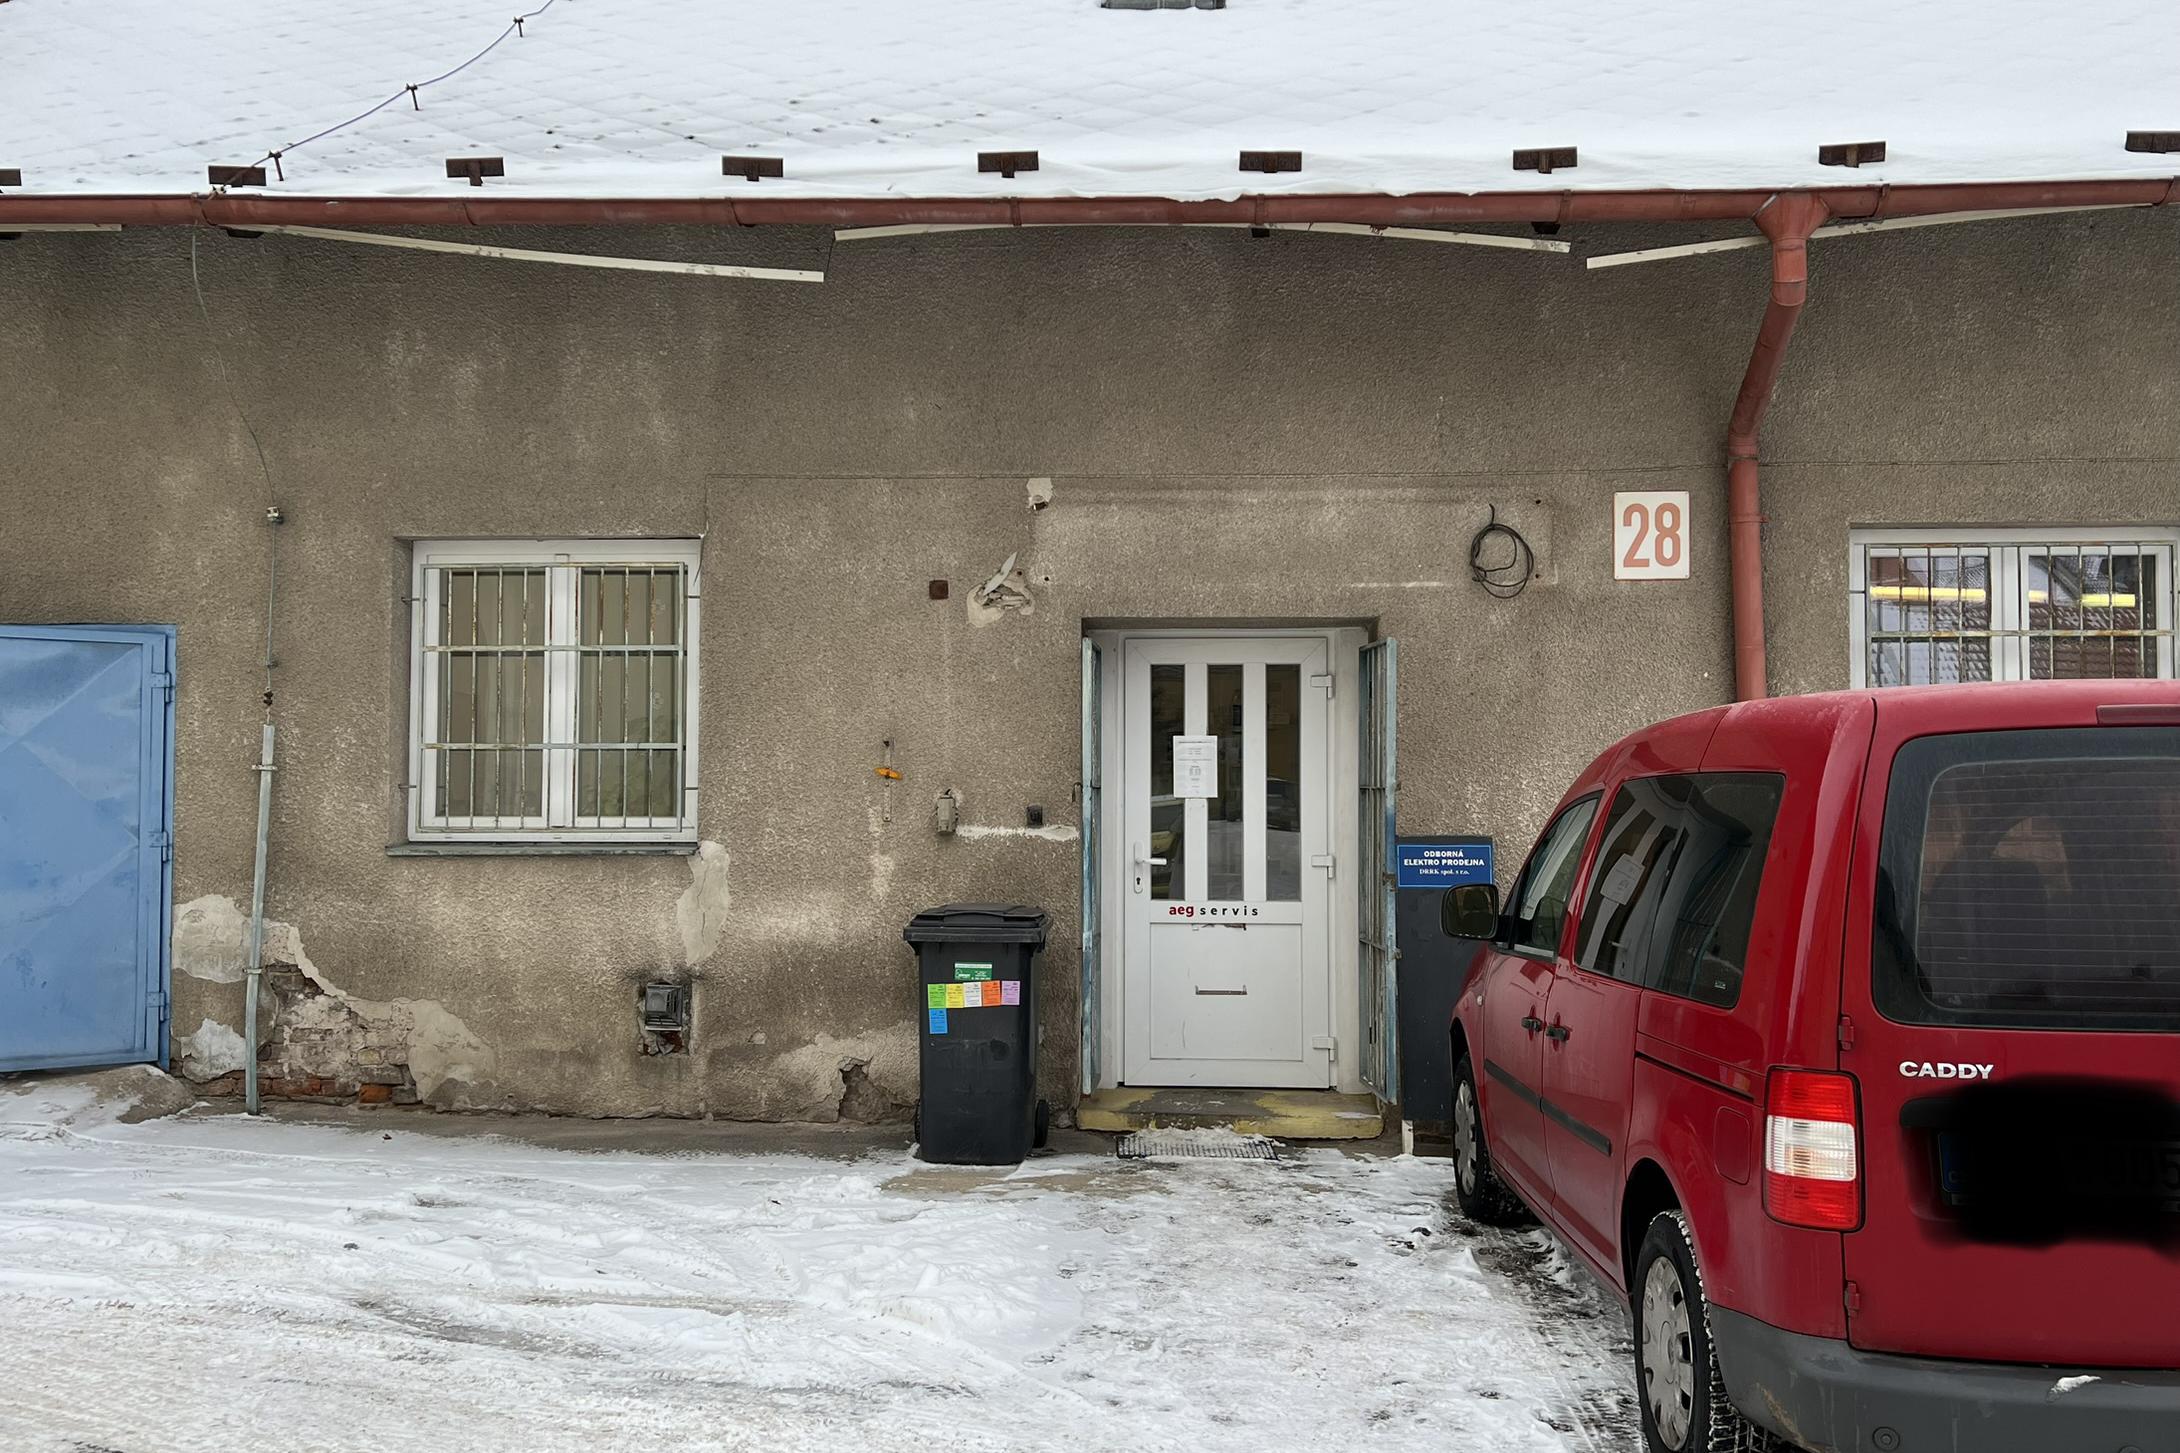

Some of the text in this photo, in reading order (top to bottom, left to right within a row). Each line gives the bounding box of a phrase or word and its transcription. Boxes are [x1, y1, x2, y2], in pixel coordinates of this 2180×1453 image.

[1623, 502, 1681, 568] 28
[1423, 849, 1464, 858] ODBORNÁ
[1168, 905, 1259, 918] aeg servis
[1899, 1061, 1994, 1080] CADDY
